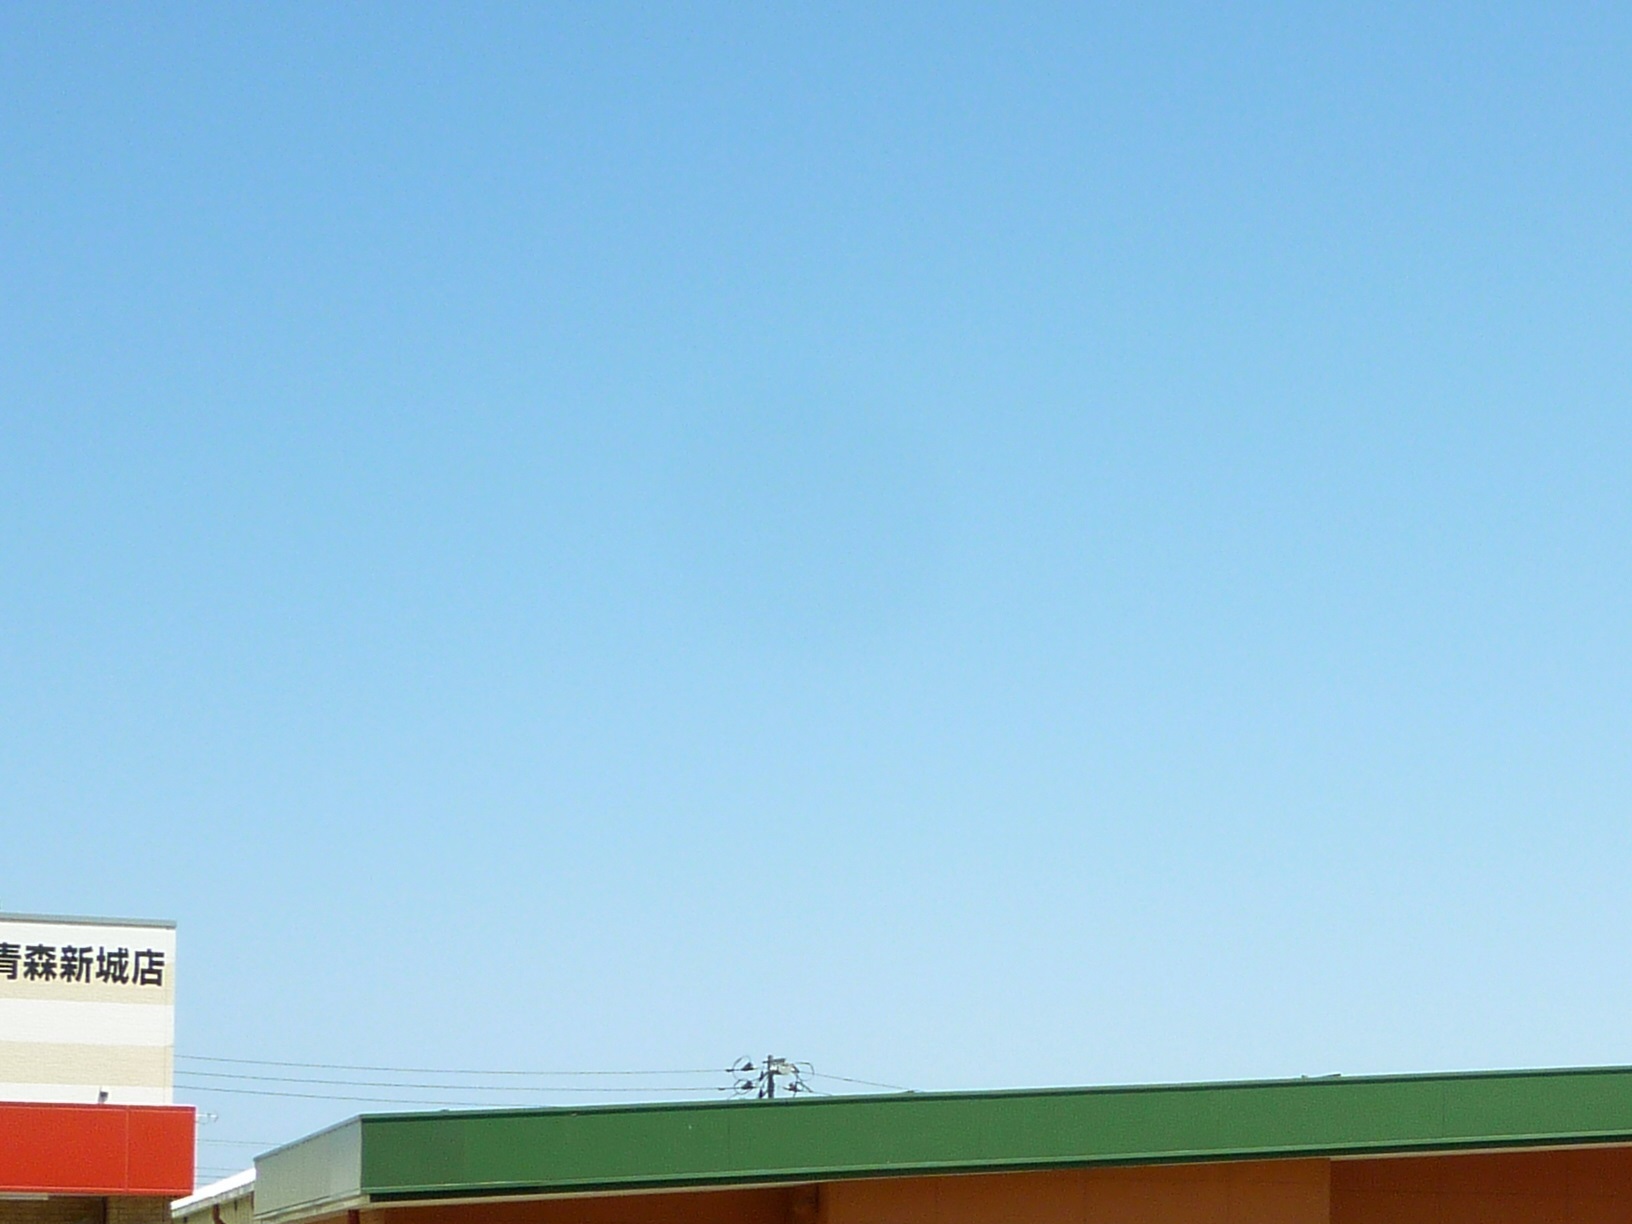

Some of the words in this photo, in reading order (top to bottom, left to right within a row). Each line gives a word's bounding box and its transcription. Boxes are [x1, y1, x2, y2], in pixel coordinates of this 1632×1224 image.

[0, 942, 165, 987] 青森新城店
